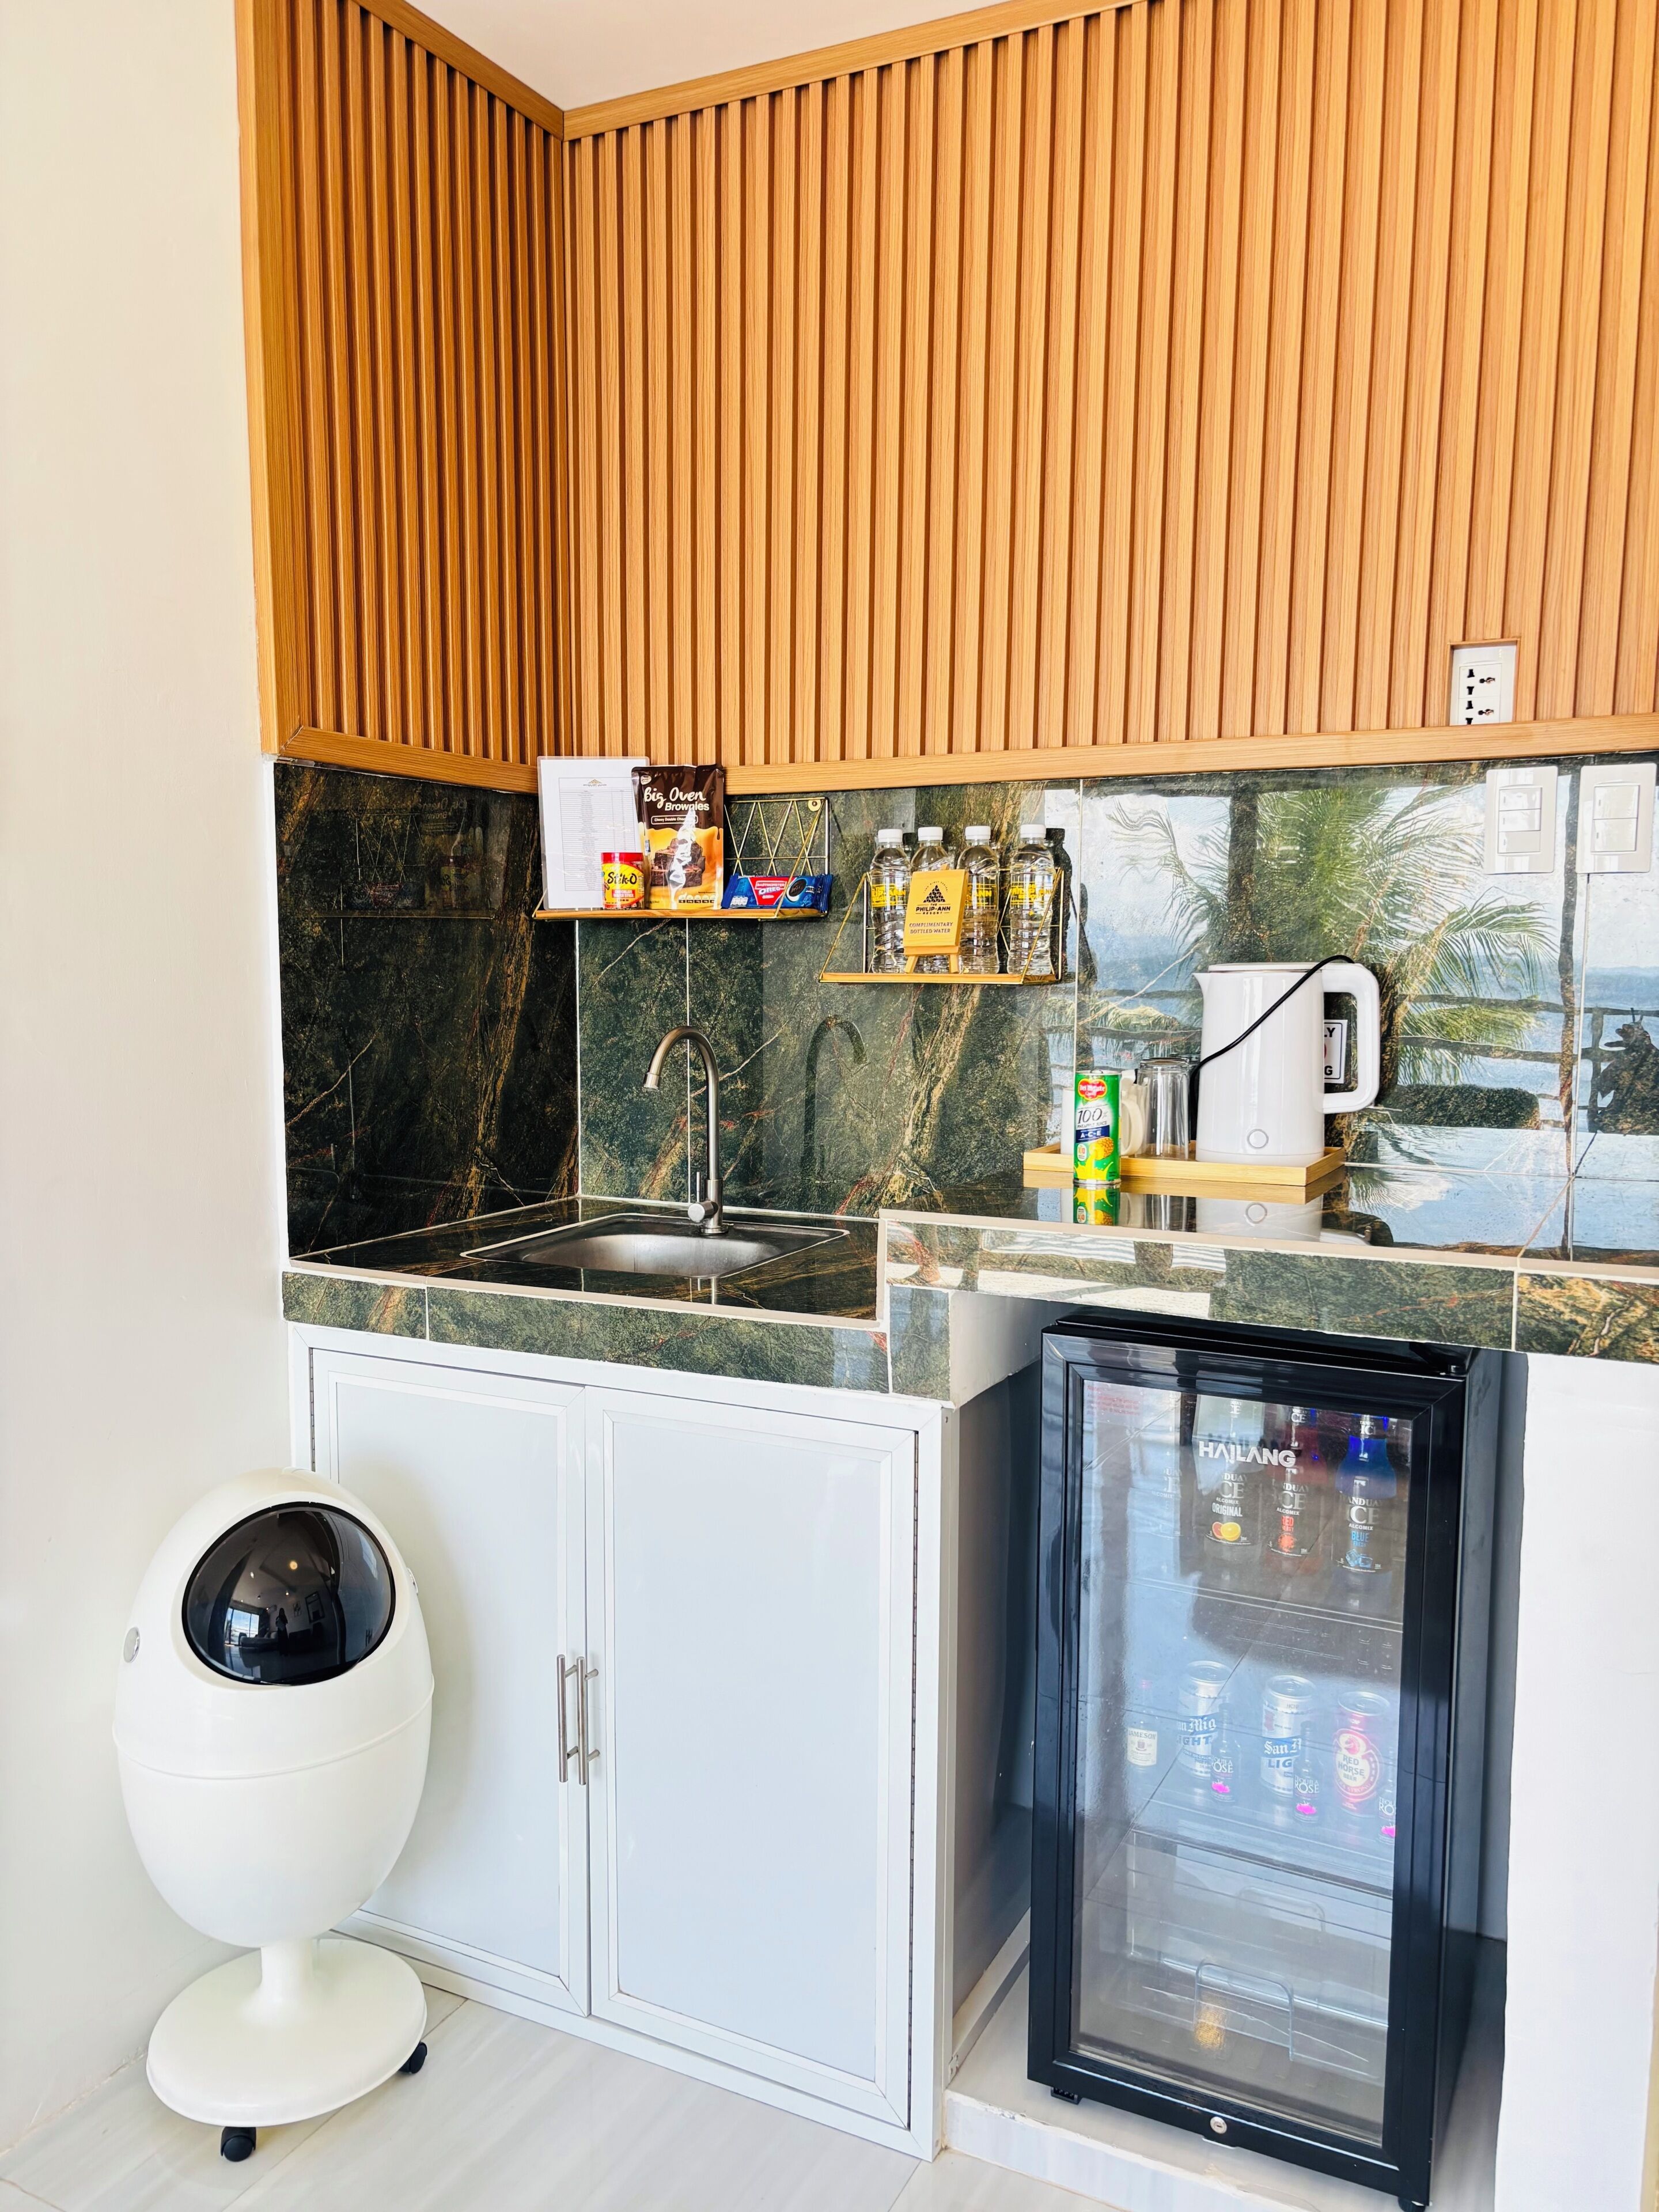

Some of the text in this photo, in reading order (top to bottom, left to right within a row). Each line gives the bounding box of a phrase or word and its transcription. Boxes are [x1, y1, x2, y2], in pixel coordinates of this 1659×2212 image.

[669, 787, 707, 801] Oven
[665, 802, 710, 811] Brownies
[758, 887, 781, 895] OREO
[1199, 1441, 1296, 1468] HAILANG
[1212, 1502, 1243, 1517] ORIGINAL
[1277, 1507, 1300, 1516] ALCOMIX
[1351, 1531, 1369, 1542] BLUE
[1188, 1717, 1217, 1733] Mig
[1128, 1730, 1156, 1740] JAMESON
[1264, 1740, 1289, 1755] San
[1267, 1759, 1292, 1768] LIG
[1343, 1754, 1359, 1766] RED
[1338, 1761, 1365, 1776] HORSE
[1343, 1773, 1357, 1782] BEER
[1294, 1780, 1319, 1794] ROSE
[1379, 1802, 1395, 1816] RO
